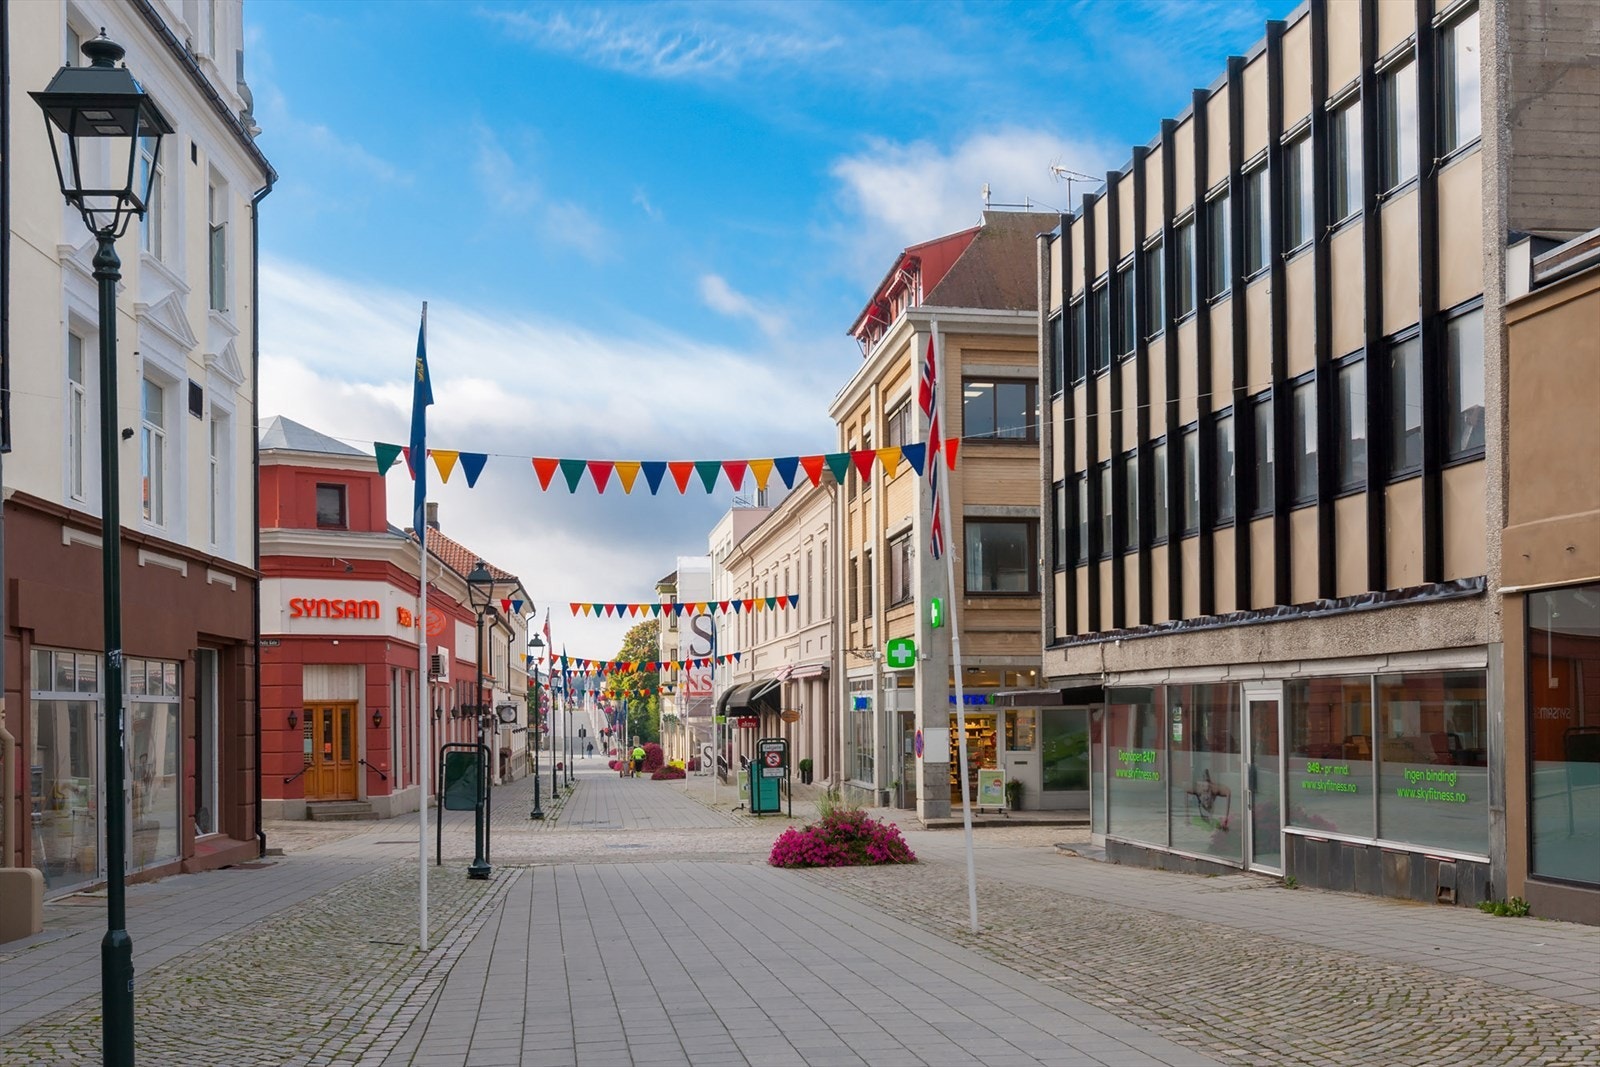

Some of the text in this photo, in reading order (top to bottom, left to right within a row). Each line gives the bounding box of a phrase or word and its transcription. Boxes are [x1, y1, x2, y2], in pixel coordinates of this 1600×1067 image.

[289, 598, 380, 620] SYNSAM
[1143, 751, 1156, 763] 24/7
[1404, 767, 1457, 787] Ingen binding!
[1301, 779, 1356, 793] www.skyfitness.no
[1396, 787, 1466, 803] www.skyfitness.no
